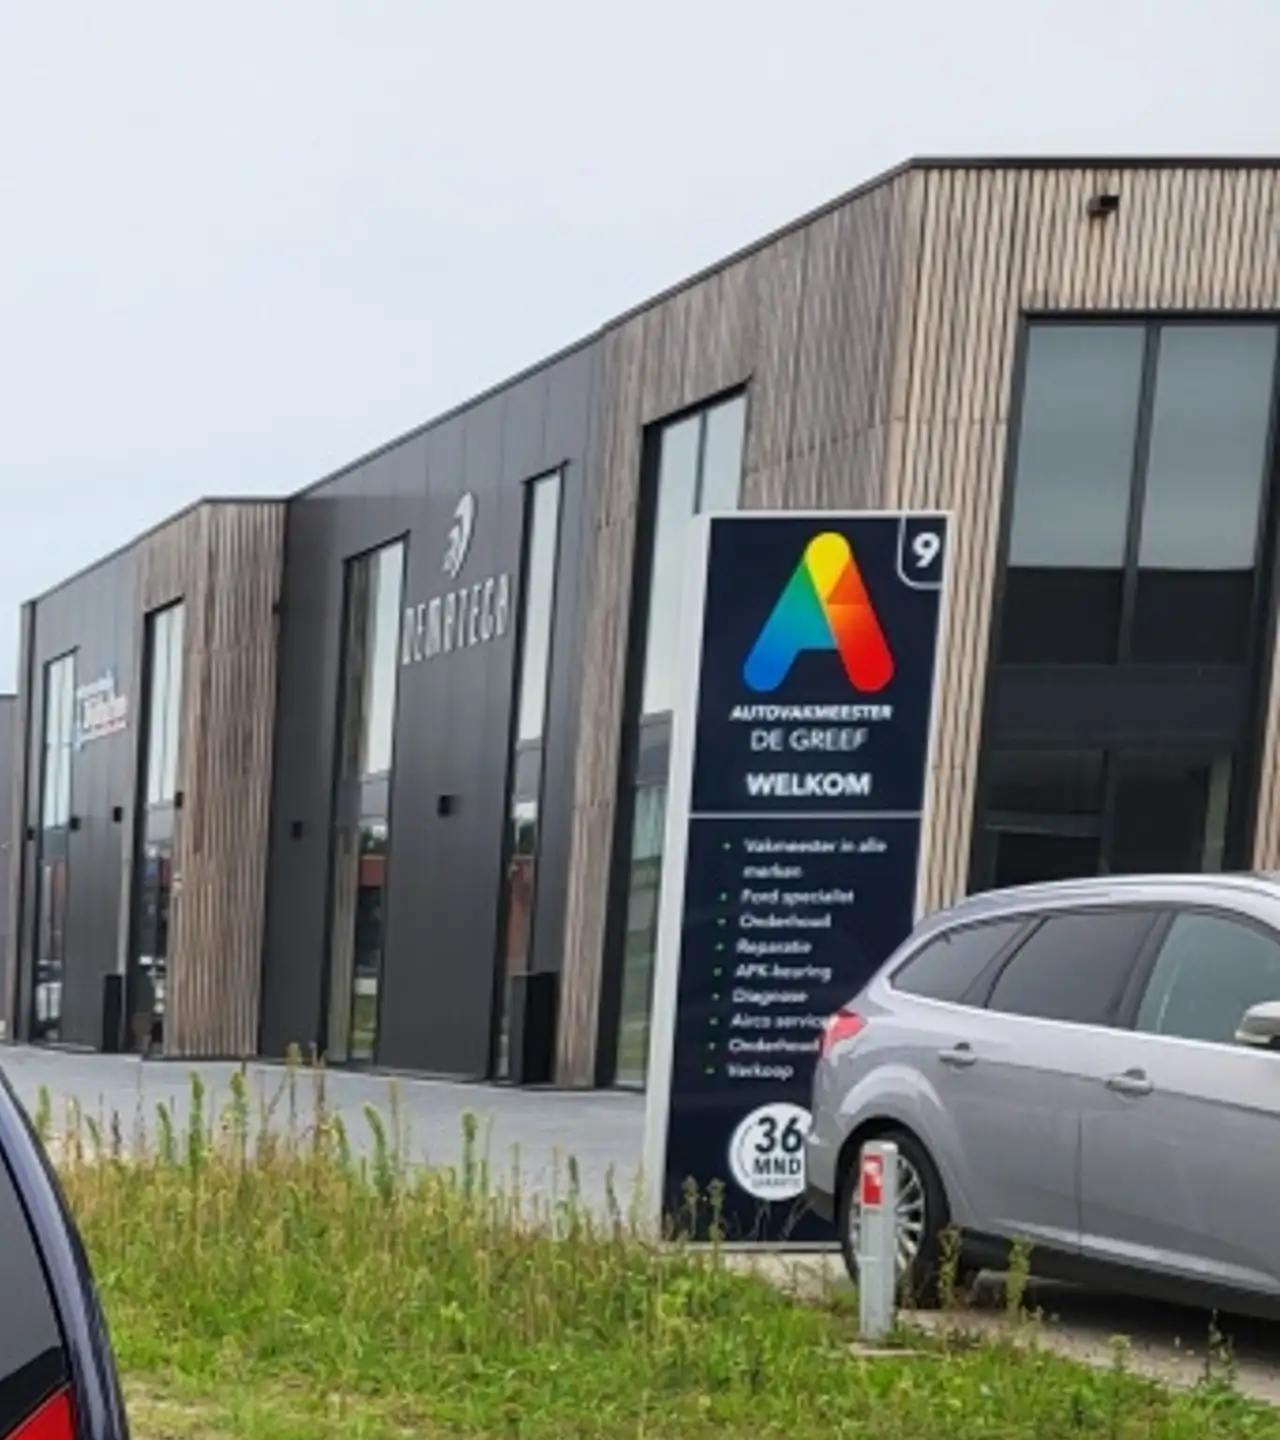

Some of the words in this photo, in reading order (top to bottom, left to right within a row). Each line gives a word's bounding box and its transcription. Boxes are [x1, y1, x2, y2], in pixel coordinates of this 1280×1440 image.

[911, 531, 941, 567] 9
[729, 704, 893, 722] AUTOVAKMEESTER
[750, 728, 782, 751] DE
[789, 727, 868, 751] GREEF
[746, 772, 873, 796] WELKOM
[743, 837, 835, 853] Vakmeester
[740, 889, 779, 904] Ford
[782, 889, 855, 906] specialist
[739, 914, 832, 929] Onderhoud
[736, 938, 812, 957] Reparatie
[727, 1063, 794, 1081] Verkoop
[754, 1115, 802, 1154] 36
[752, 1157, 801, 1175] MND
